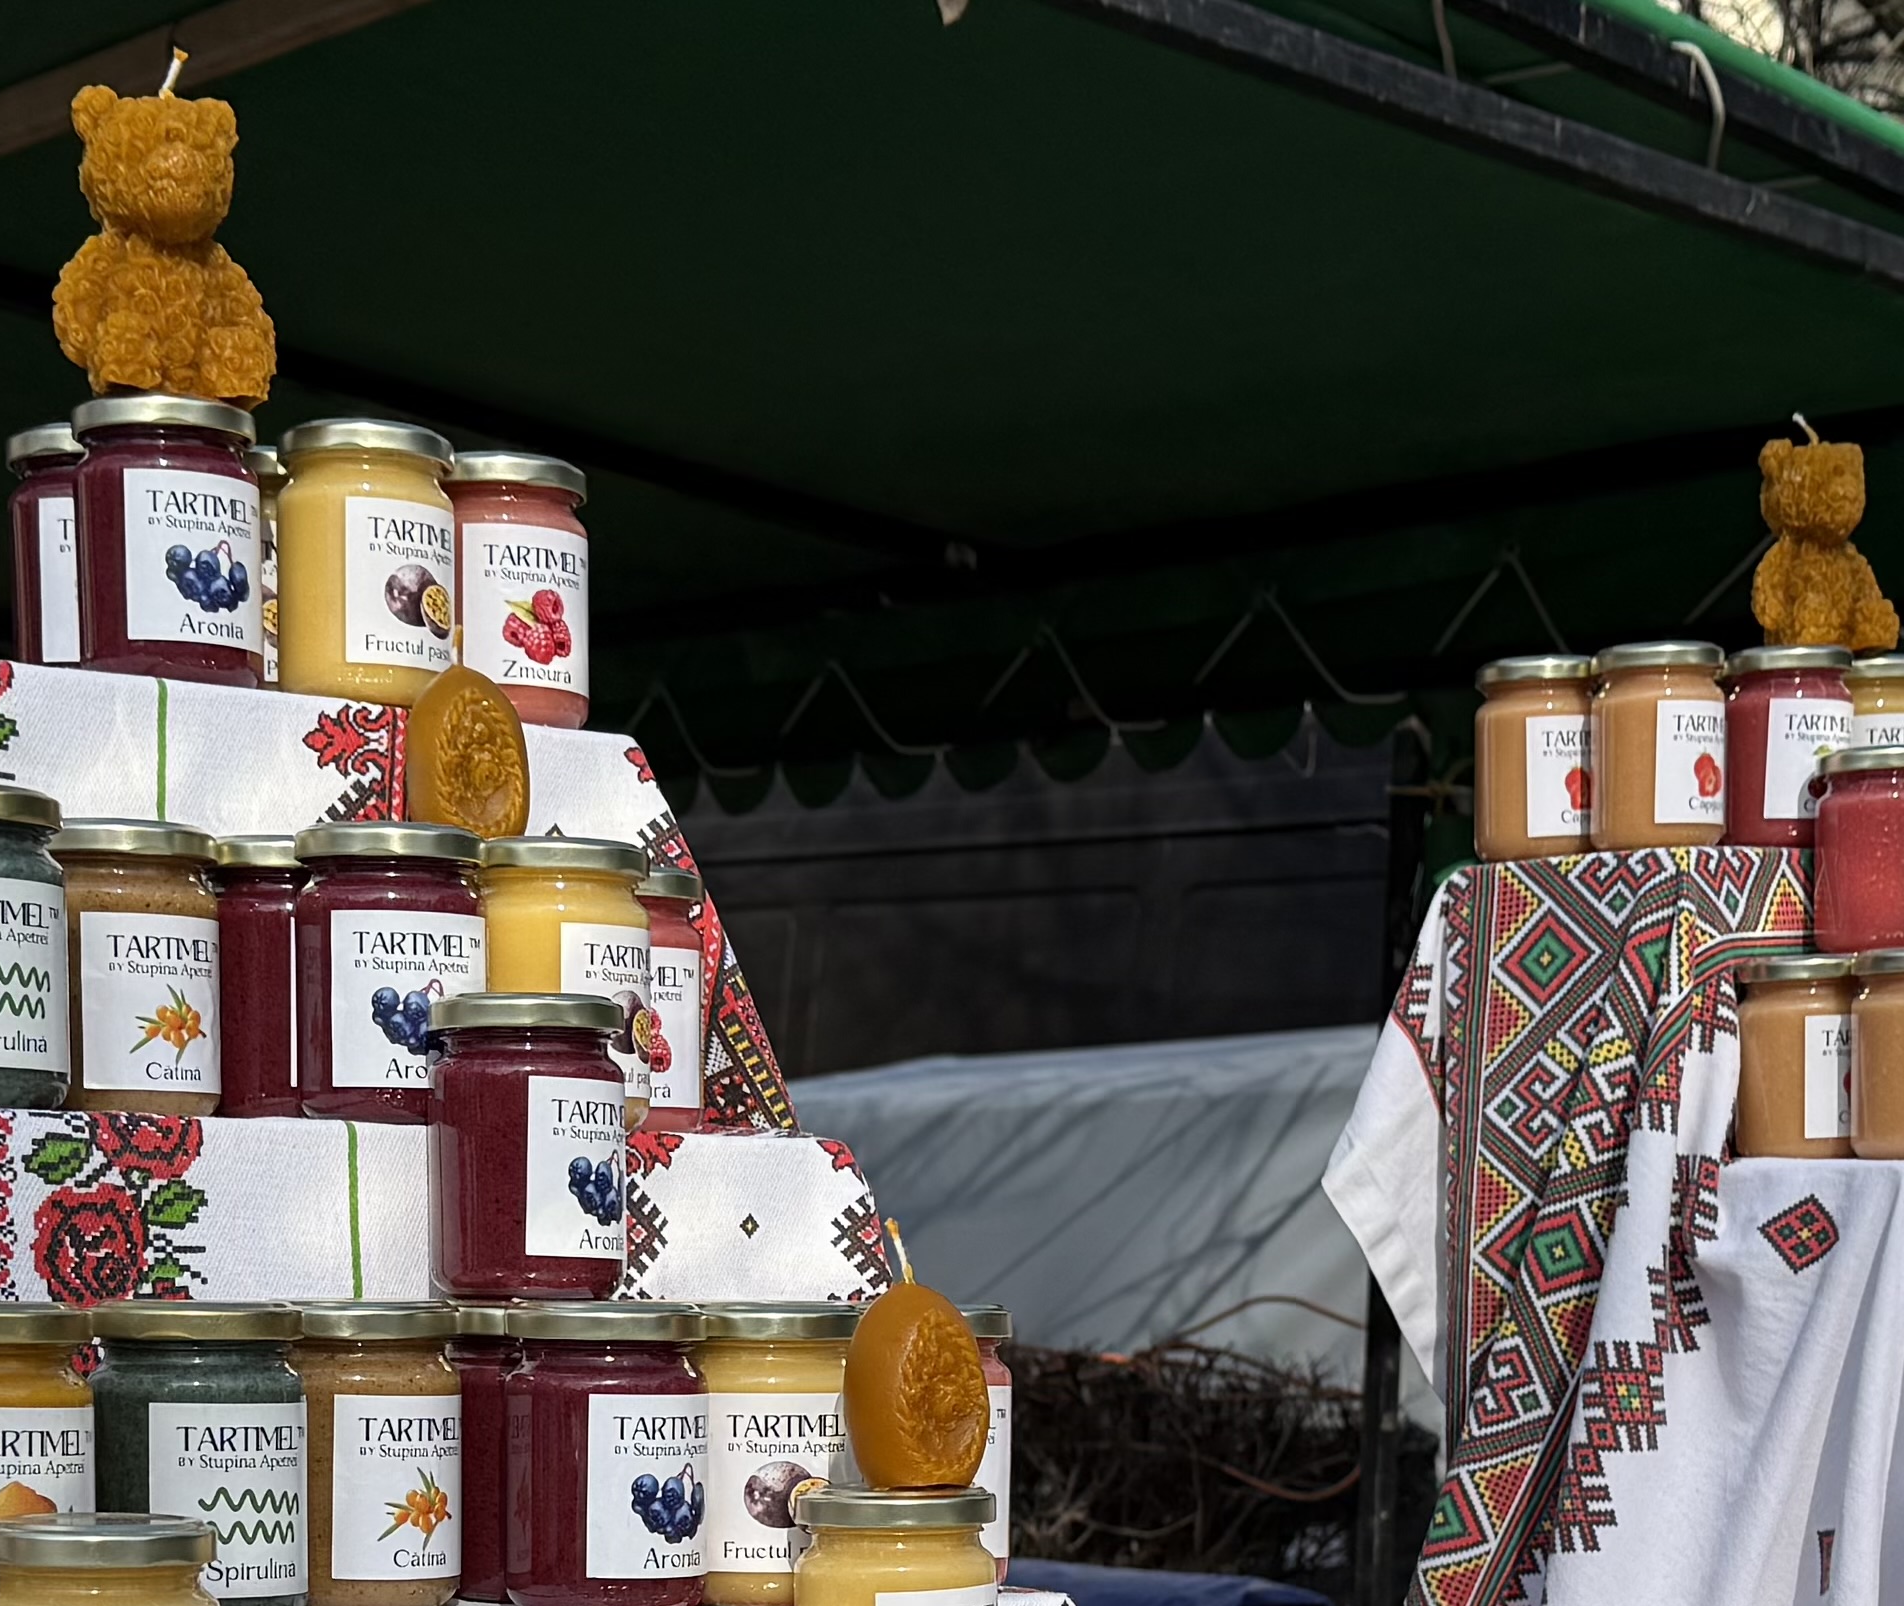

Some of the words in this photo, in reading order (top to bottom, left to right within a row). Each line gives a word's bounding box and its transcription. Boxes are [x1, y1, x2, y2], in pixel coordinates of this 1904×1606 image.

[166, 515, 214, 532] Stupina
[500, 568, 547, 585] Stupina
[180, 614, 244, 640] Aronia
[365, 634, 424, 658] Fructul
[6, 929, 49, 948] Apetrei
[128, 960, 178, 975] Stupina
[372, 957, 425, 971] Stupina
[428, 959, 469, 974] Apetrei
[570, 1125, 611, 1141] Stupina
[379, 1442, 426, 1460] Stupina
[633, 1442, 680, 1457] Stupina
[745, 1439, 800, 1456] Stupina
[200, 1454, 256, 1471] Stupina
[644, 1548, 700, 1569] Aronia
[723, 1541, 791, 1559] Fructul
